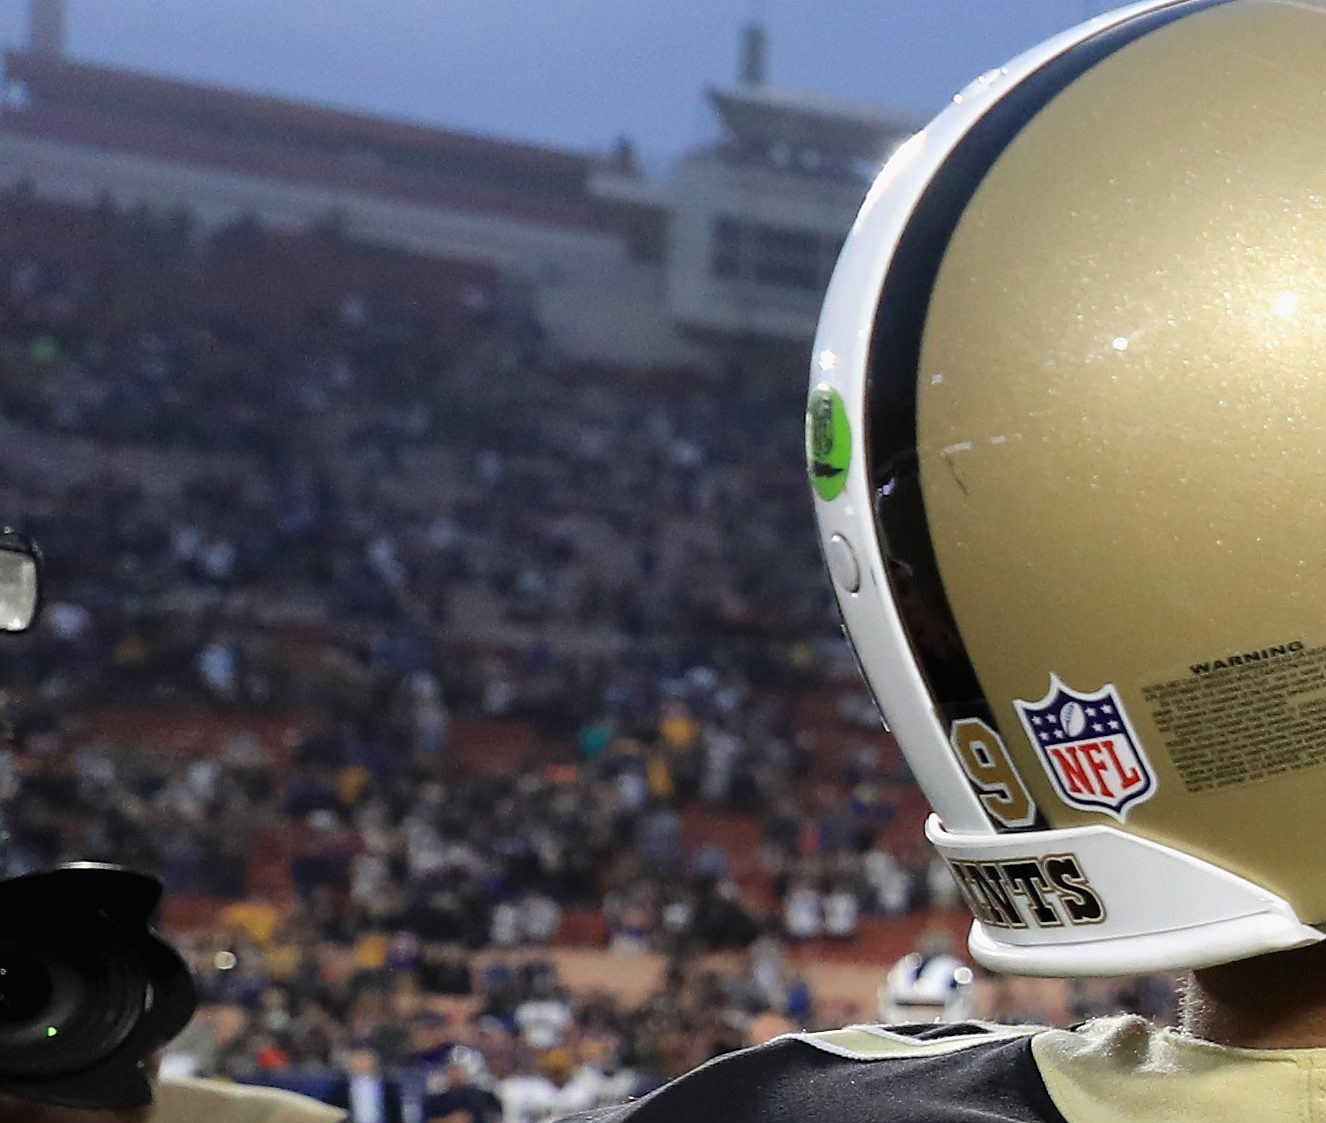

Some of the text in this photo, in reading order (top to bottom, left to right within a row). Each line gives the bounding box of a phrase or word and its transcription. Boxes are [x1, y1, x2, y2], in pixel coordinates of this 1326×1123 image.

[1189, 640, 1303, 674] WARNING
[950, 716, 1037, 828] 9
[1051, 739, 1143, 798] NFL
